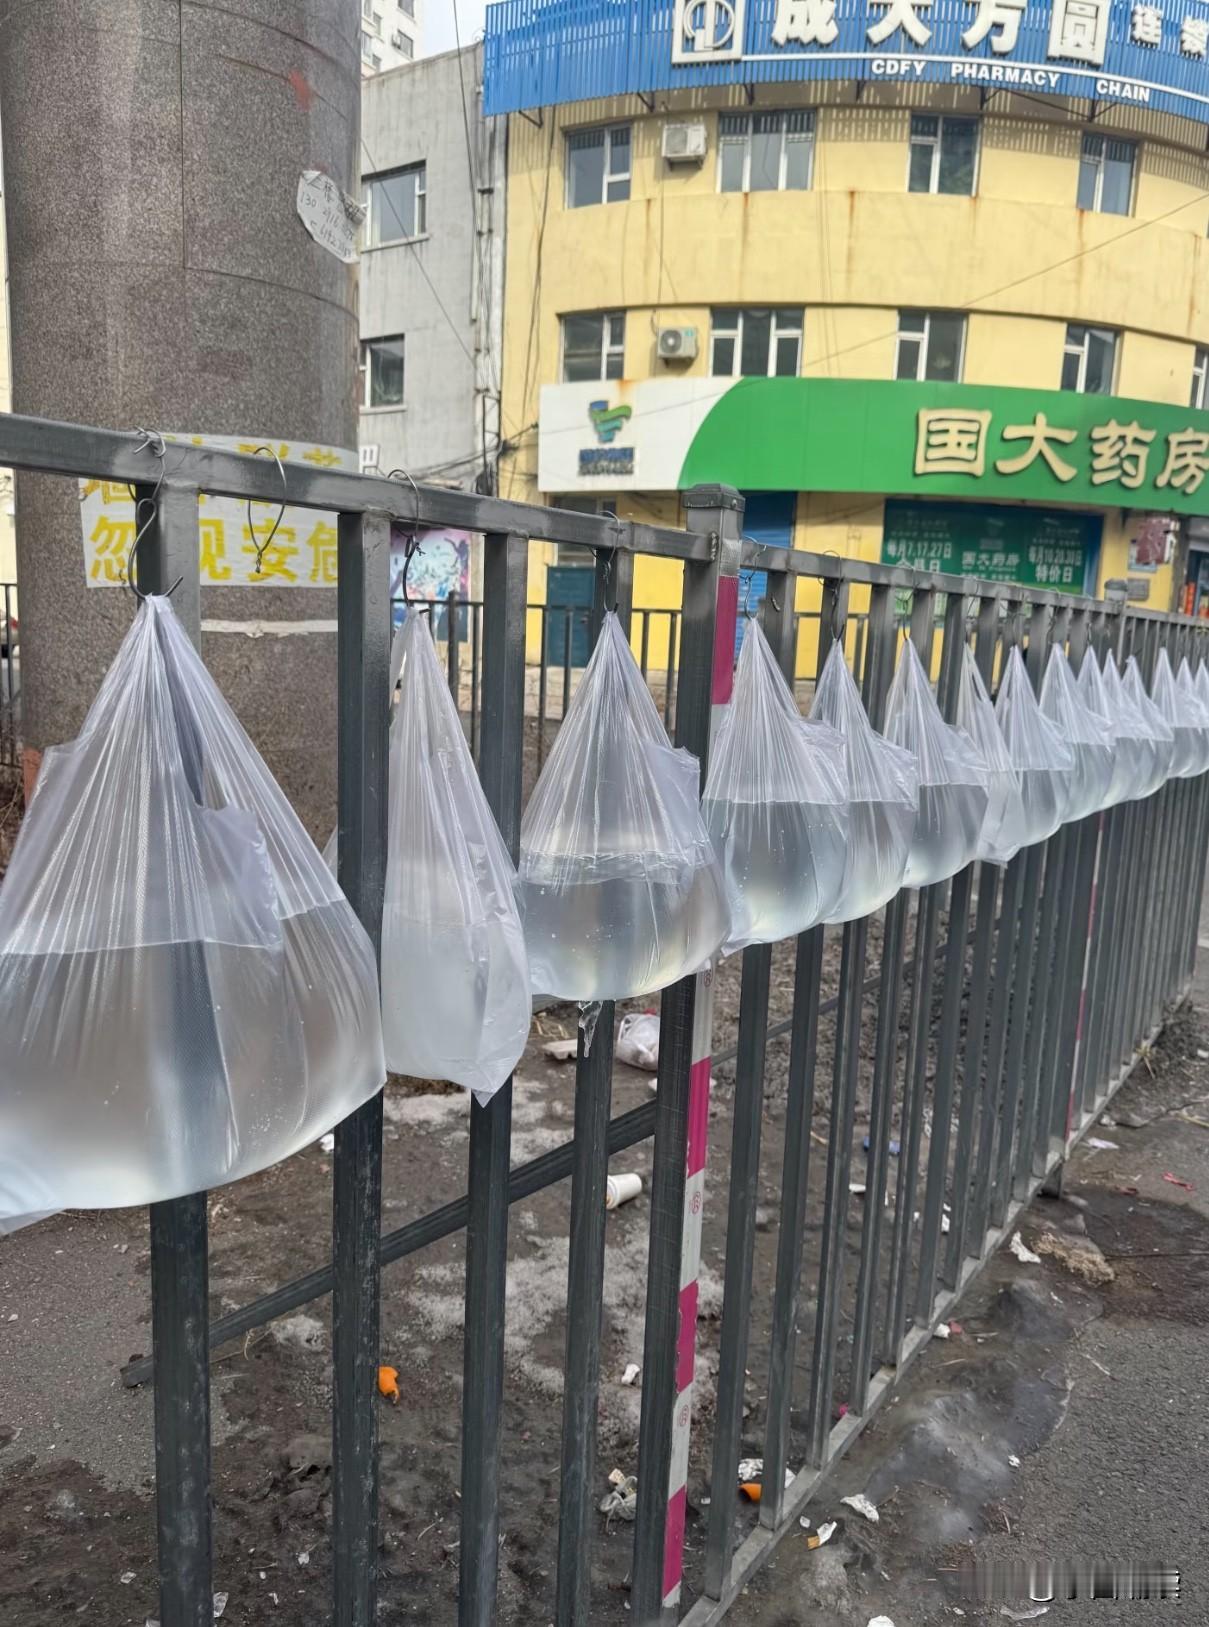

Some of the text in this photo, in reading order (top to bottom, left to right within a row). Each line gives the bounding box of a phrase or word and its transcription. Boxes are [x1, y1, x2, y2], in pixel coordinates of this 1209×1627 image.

[871, 59, 1150, 102] CDFY PHARMACY CHAIN
[914, 408, 1209, 495] 国大药房
[1035, 563, 1074, 583] 特价日
